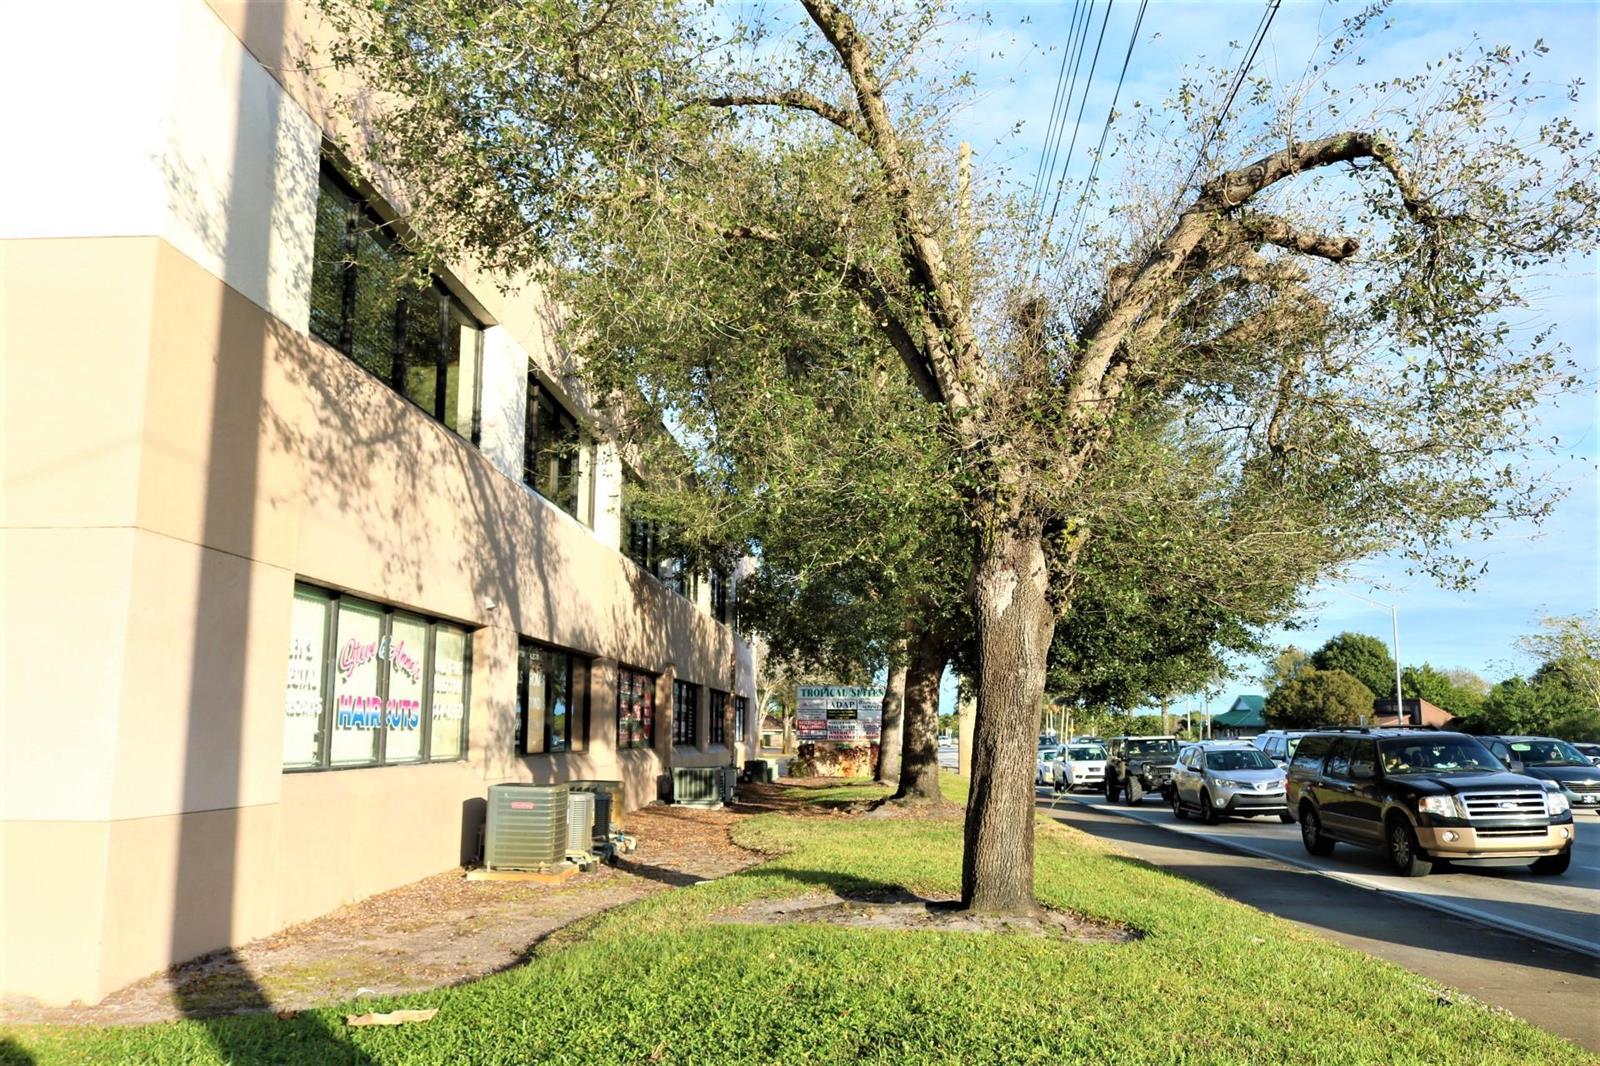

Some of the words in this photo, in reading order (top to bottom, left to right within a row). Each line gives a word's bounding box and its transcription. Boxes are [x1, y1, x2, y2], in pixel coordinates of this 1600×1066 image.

[801, 688, 847, 698] TROPICAL
[337, 694, 383, 730] HAIR
[385, 699, 420, 730] CUTS
